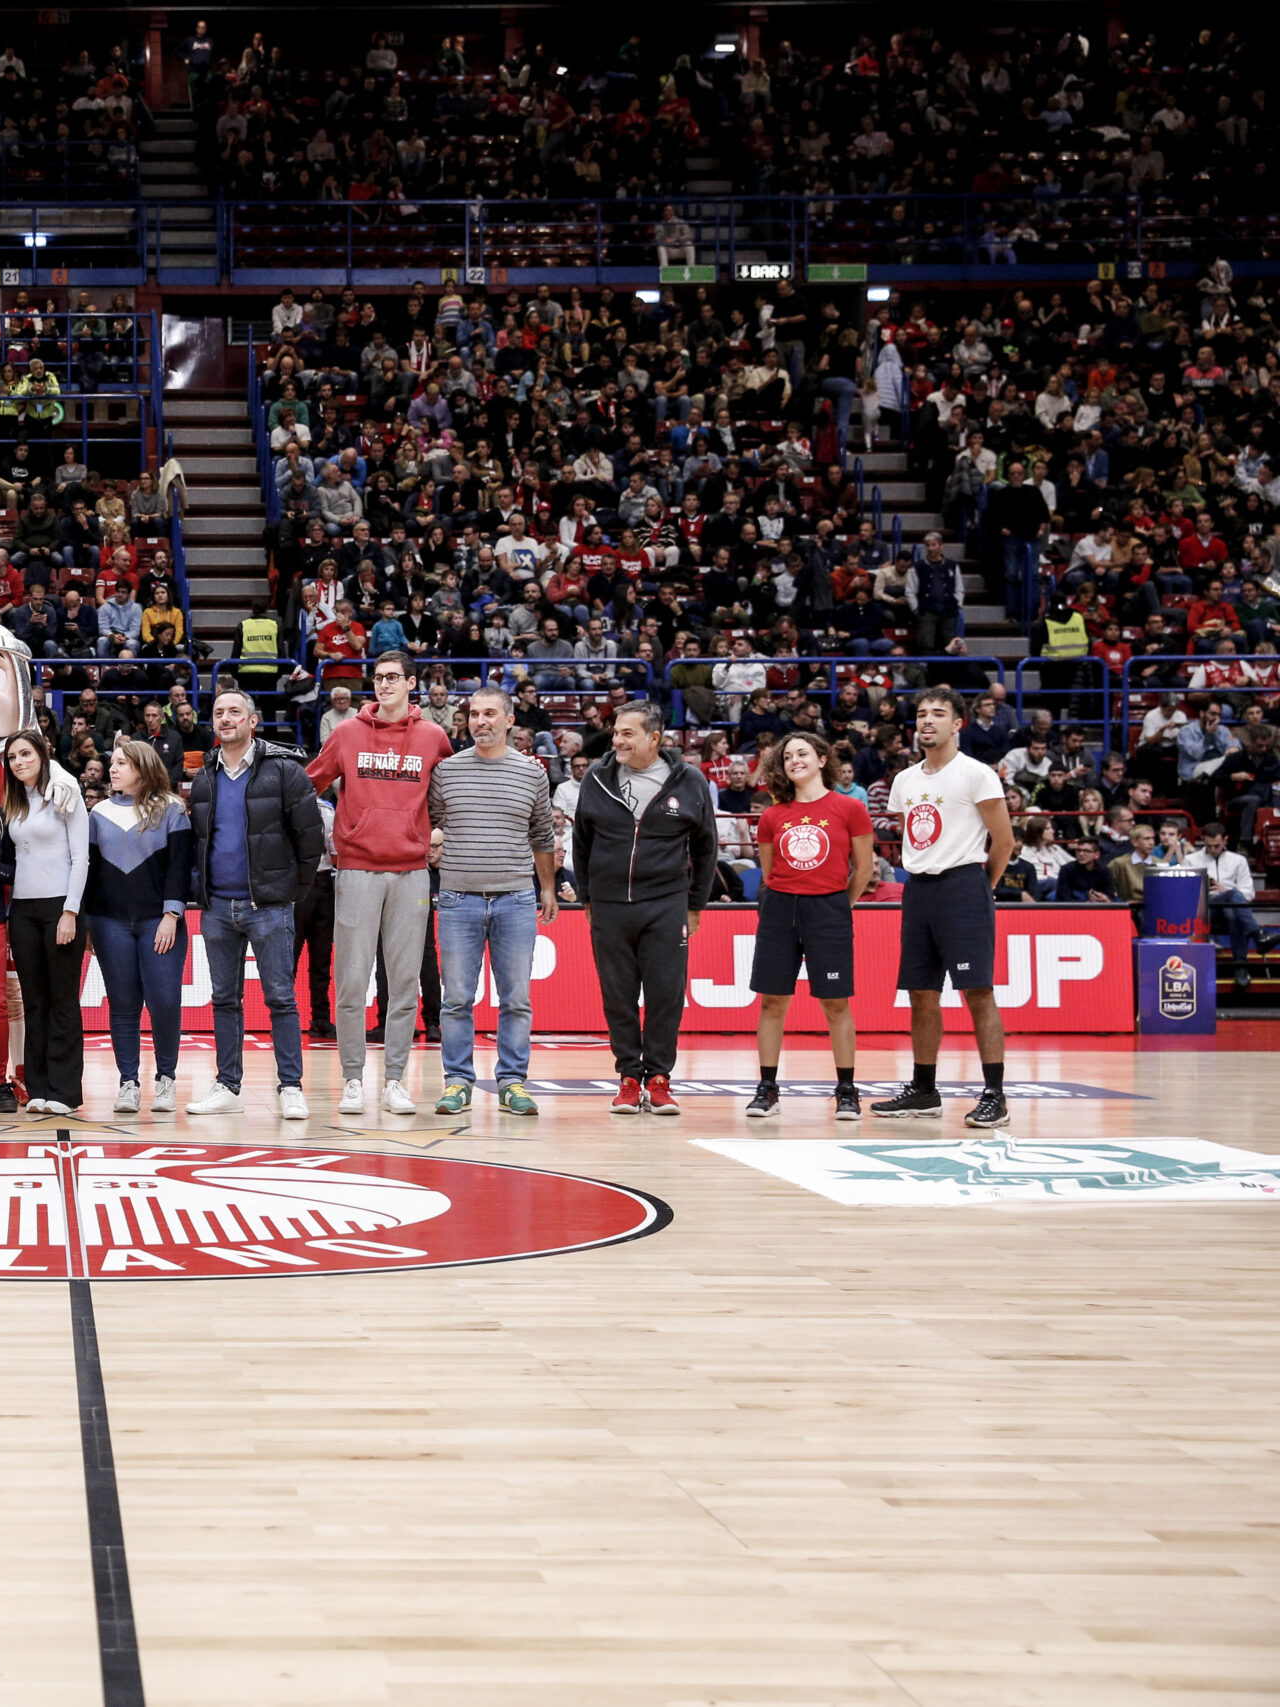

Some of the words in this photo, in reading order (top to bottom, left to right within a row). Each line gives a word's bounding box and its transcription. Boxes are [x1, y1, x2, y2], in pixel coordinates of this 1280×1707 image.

[4, 271, 18, 282] 21
[469, 270, 484, 281] 22
[750, 264, 780, 278] BAR
[912, 805, 935, 816] OLIMPIA
[789, 827, 818, 836] OLIMPIA
[913, 839, 932, 850] MILANO
[792, 859, 818, 868] MILANO
[1156, 917, 1191, 934] Red
[1194, 918, 1211, 934] Bu
[1165, 982, 1192, 992] LBA
